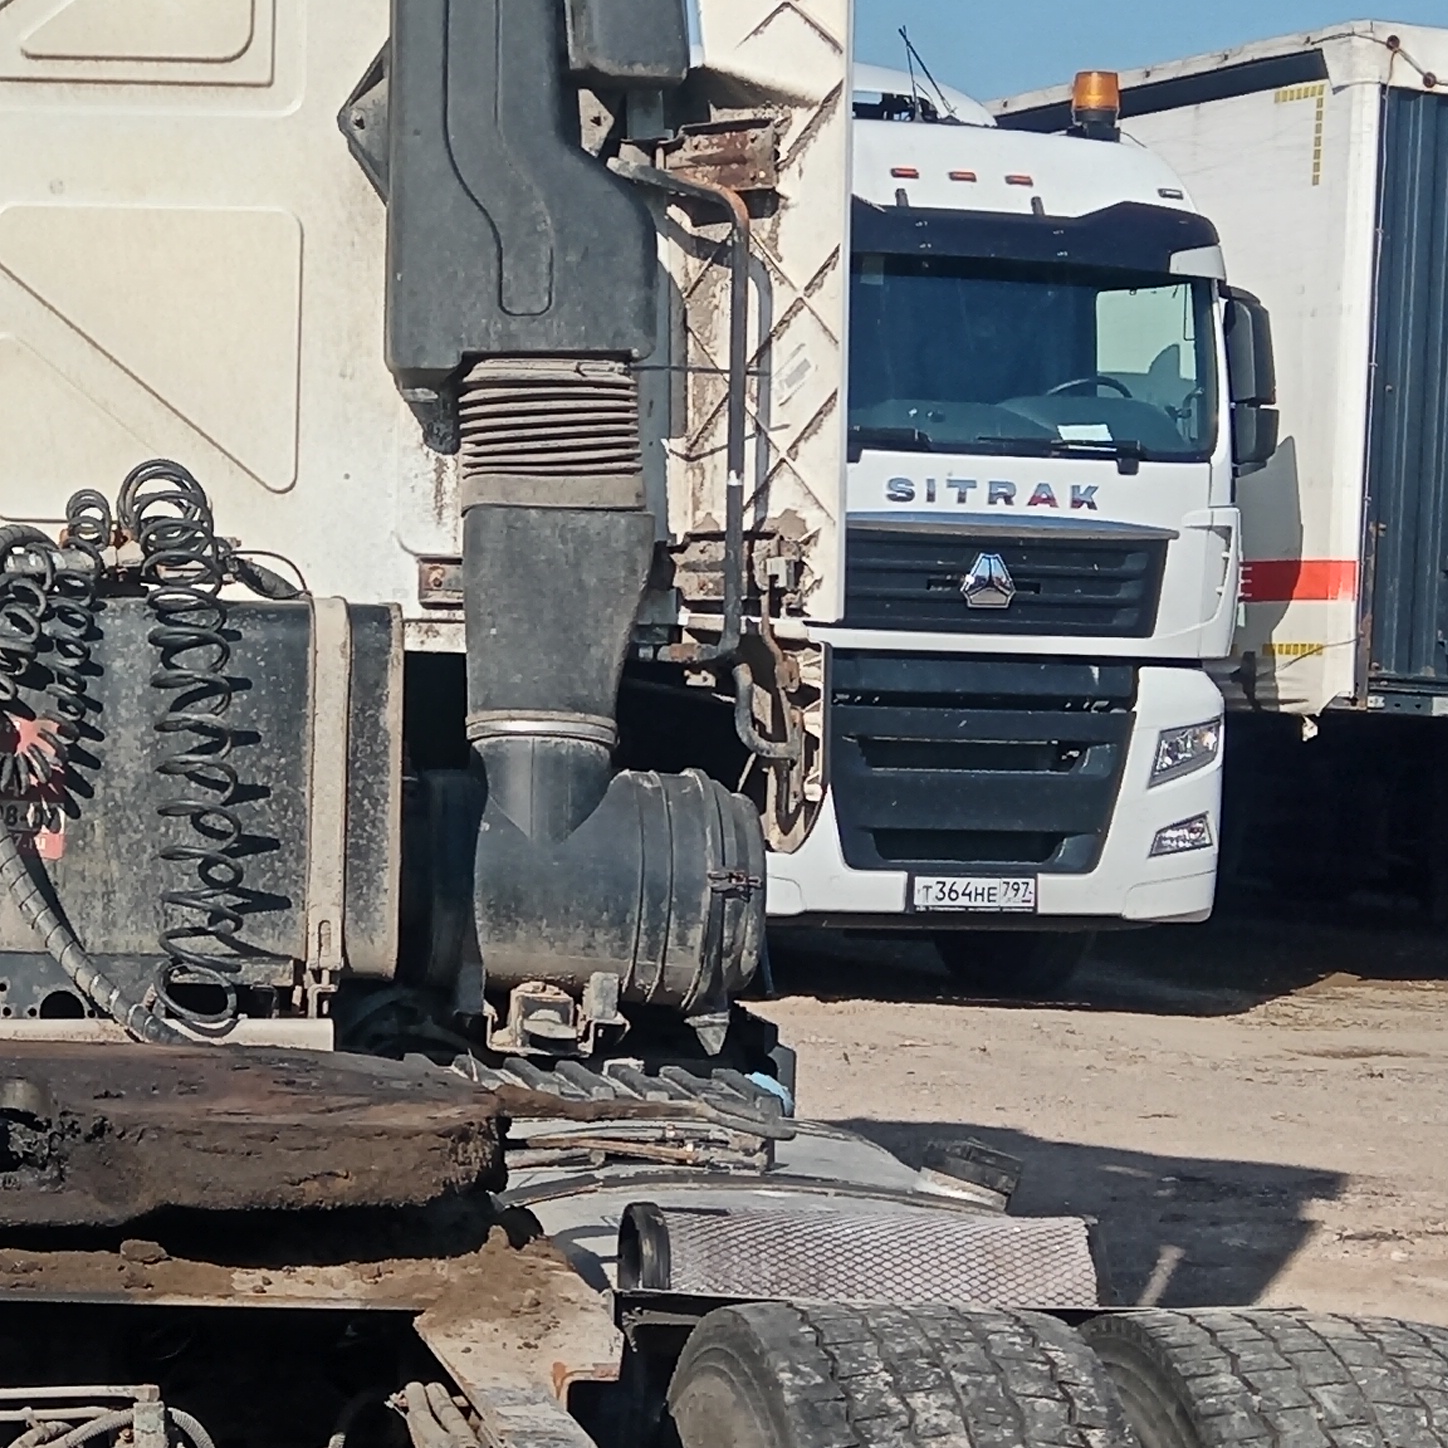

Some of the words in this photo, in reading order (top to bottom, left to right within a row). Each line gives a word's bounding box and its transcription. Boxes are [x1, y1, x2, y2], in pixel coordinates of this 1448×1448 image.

[885, 476, 1099, 511] SITRAK
[922, 880, 997, 903] Т364НЕ
[1002, 881, 1030, 898] 797
